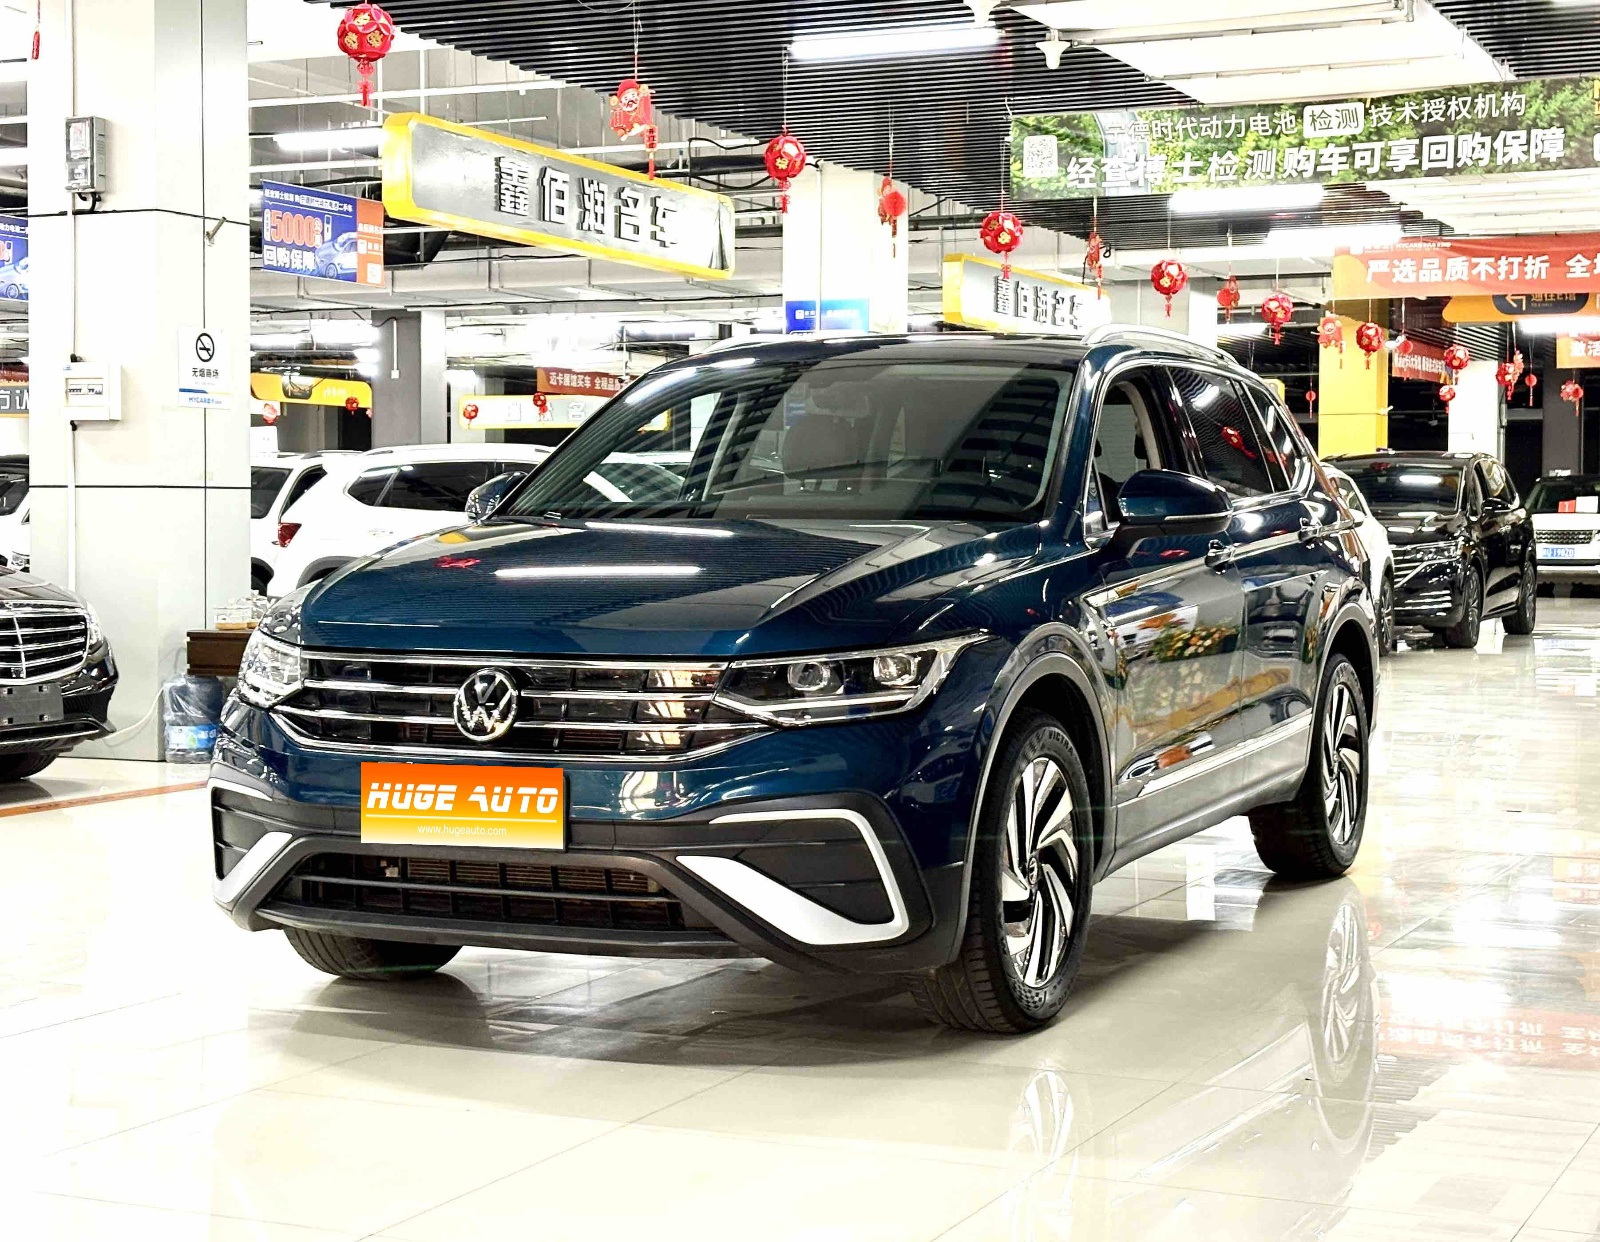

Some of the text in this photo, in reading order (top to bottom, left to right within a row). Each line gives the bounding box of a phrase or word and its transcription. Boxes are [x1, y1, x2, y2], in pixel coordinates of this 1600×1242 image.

[1105, 90, 1526, 143] 宁德时代动力电池 检测 技术授权机构
[1067, 127, 1565, 189] 经查博士检测购车可享回购保障
[494, 155, 678, 248] 鑫佰润名车
[1366, 255, 1549, 283] 严选品质不打折
